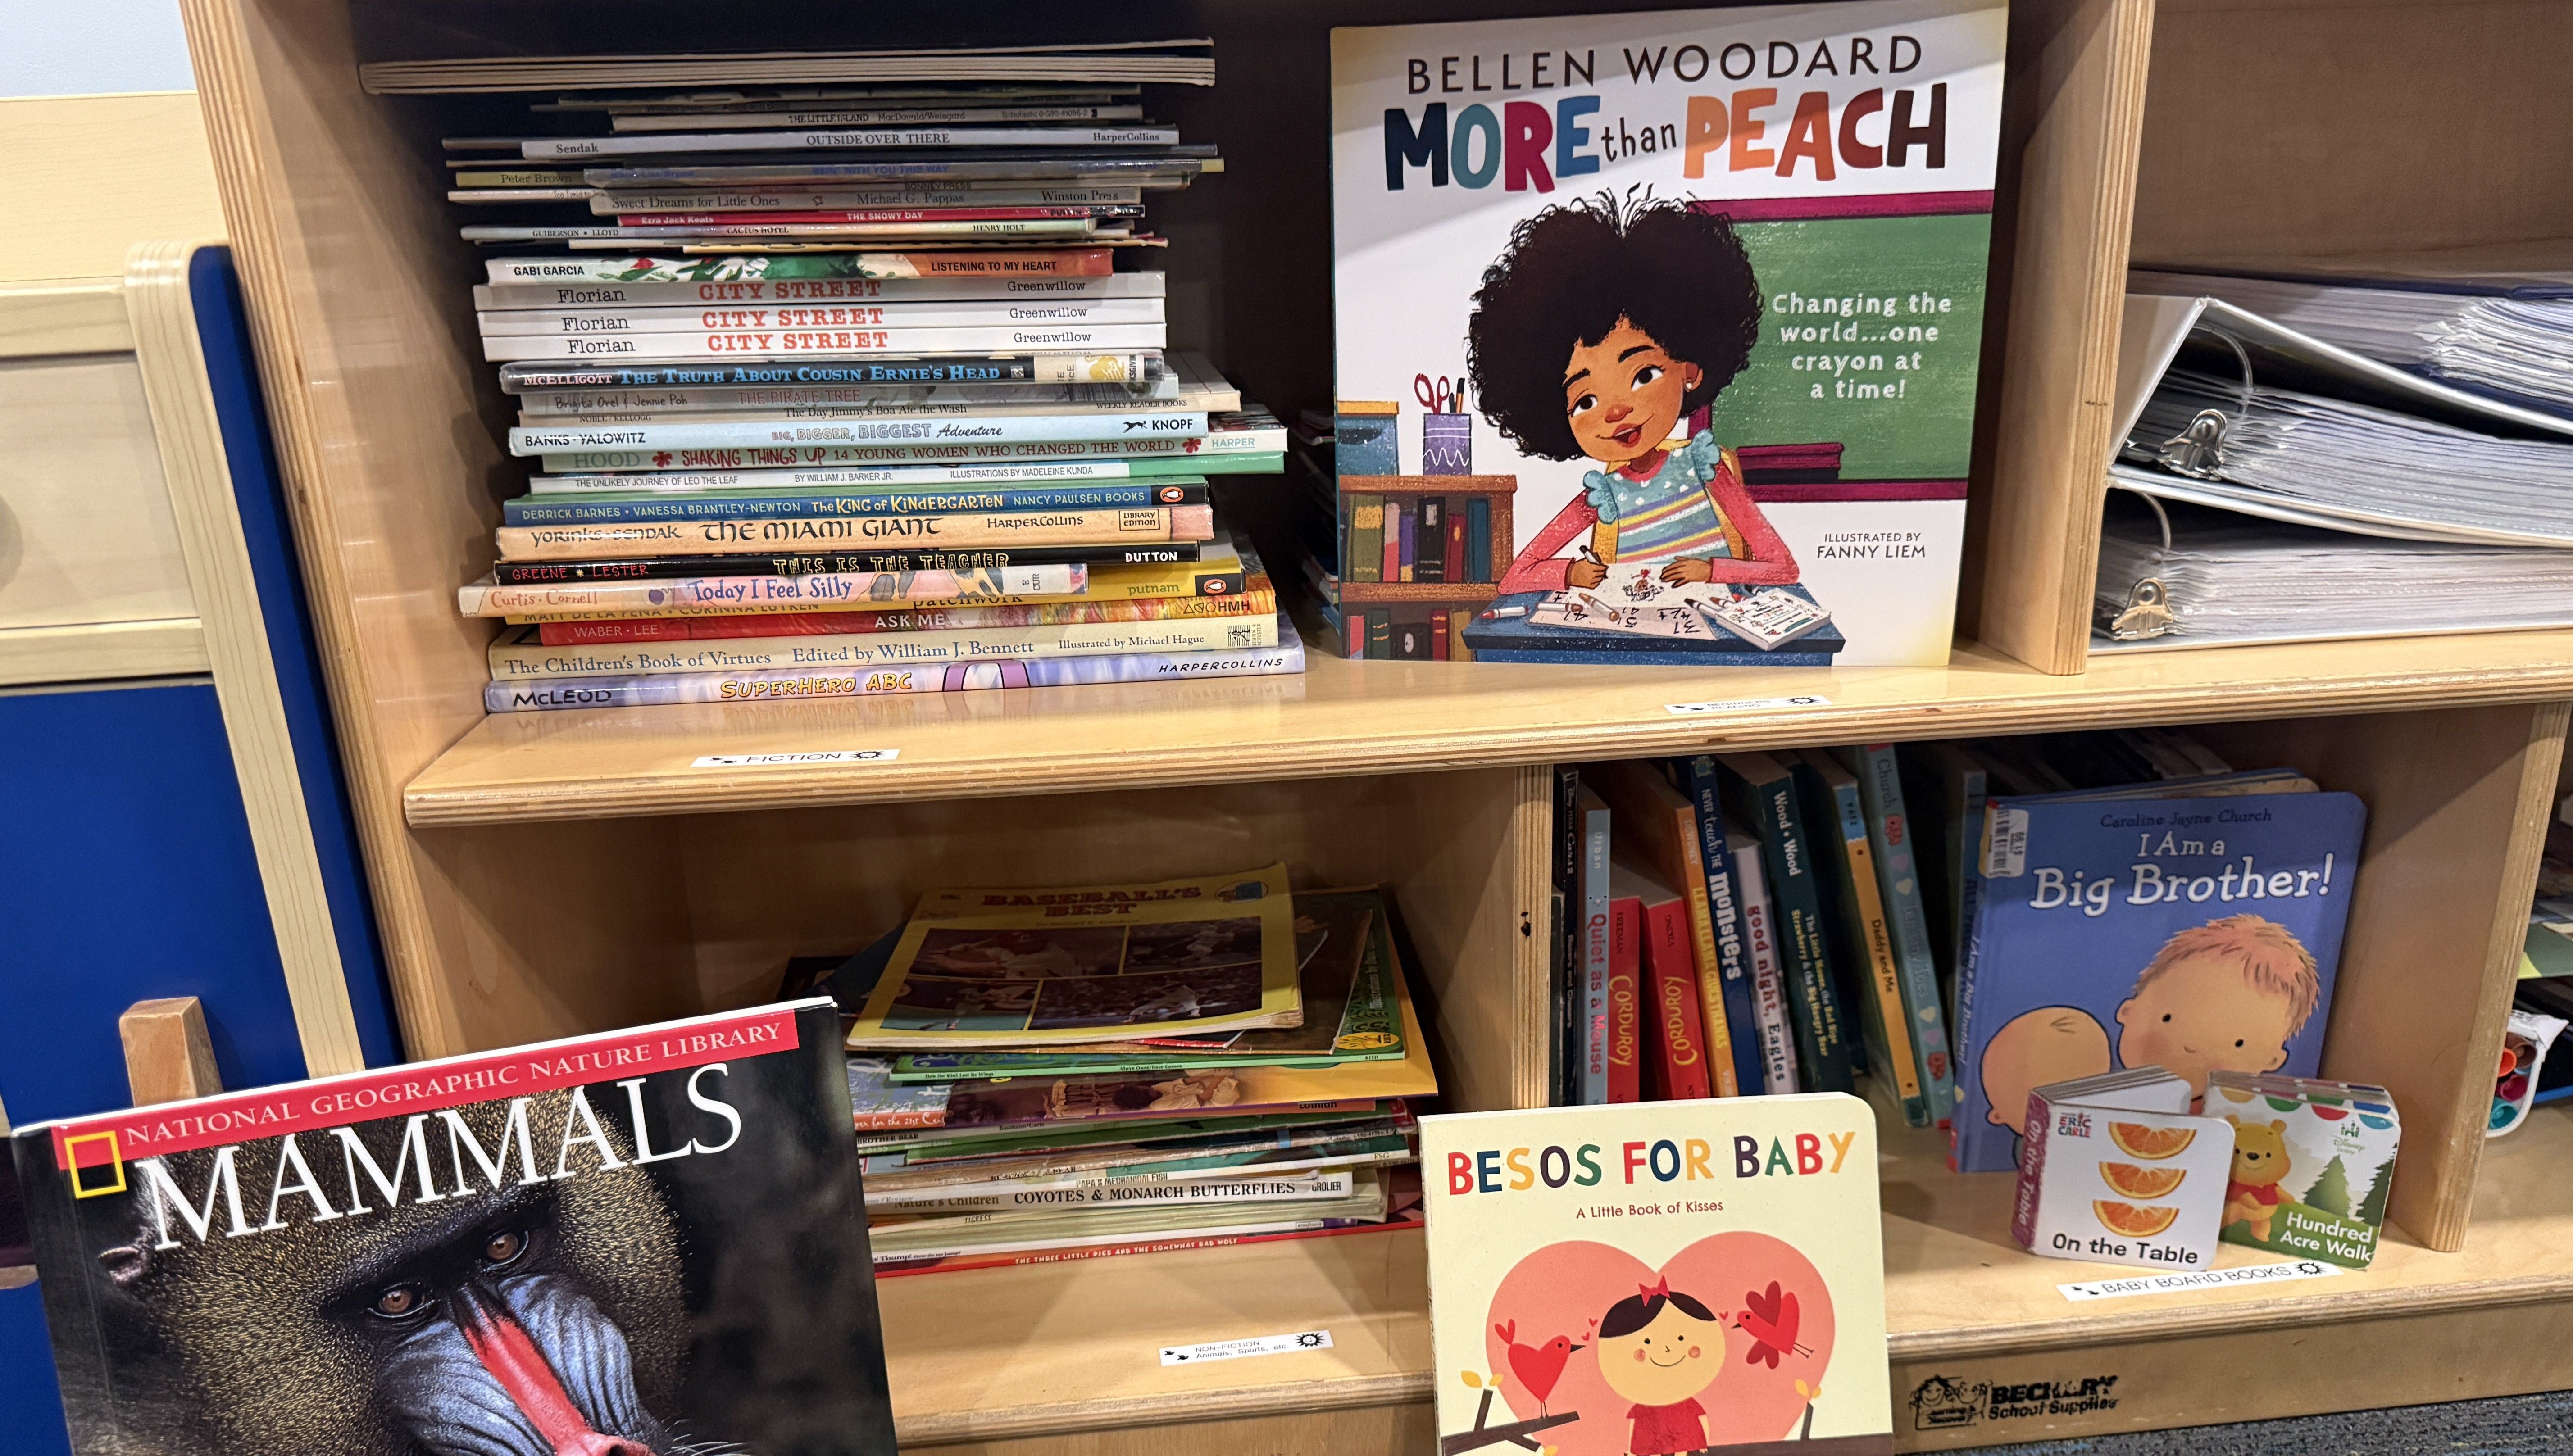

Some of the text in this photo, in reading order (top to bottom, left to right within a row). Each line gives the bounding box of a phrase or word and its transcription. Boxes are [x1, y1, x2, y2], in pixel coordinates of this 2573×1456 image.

[1408, 36, 1922, 94] BELLEN WOODARD
[807, 133, 950, 145] OUTSIDE OVER THERE
[1093, 132, 1160, 142] HarperCollins
[1384, 83, 1946, 193] MORE than PEACH
[556, 143, 599, 154] Sendak
[501, 174, 572, 183] Peter Brown
[612, 195, 780, 209] Sweet Dreams for Little Ones
[514, 265, 585, 276] GABI GARCIA
[932, 260, 1057, 272] LISTENING TO MY HEART
[699, 281, 881, 301] CITY STREET
[1008, 281, 1086, 292] Greenwillow
[557, 289, 626, 304] Florian
[1772, 292, 1952, 317] Changing the
[702, 308, 884, 328] CITY STREET
[1009, 307, 1088, 319] Greenwillow
[562, 317, 630, 331] Florian
[567, 339, 636, 354] Florian
[708, 331, 888, 351] CITY STREET
[1014, 331, 1092, 343] Greenwillow
[1791, 352, 1922, 377] crayon at
[1810, 379, 1906, 399] a time!
[1152, 419, 1193, 431] KNOPF
[834, 440, 1175, 461] 14 YOUNG WOMEN WHO CHANGED THE WORLD
[1212, 437, 1255, 448] HARPER
[1014, 492, 1145, 505] NANCY PAULSEN BOOKS
[1824, 532, 1921, 543] ILLUSTRATED BY
[1125, 552, 1178, 563] DUTTON
[1817, 545, 1926, 559] FANNY LIEM
[512, 564, 649, 581] GREENE LESTER
[687, 575, 853, 601] Today I Feel Silly
[1127, 584, 1180, 595] putnam
[1218, 601, 1250, 612] HMH
[875, 612, 946, 629] ASK ME
[574, 625, 659, 637] WABER LEE
[791, 640, 1034, 663] Edited by William J. Bennett
[505, 650, 772, 674] The Children's Book of Virtues
[1159, 658, 1283, 673] HARPERCOLLINS
[720, 672, 913, 699] SUPERHERO ABC
[746, 753, 841, 762] FICTION
[2101, 808, 2272, 828] Caroline Jayne Church
[1773, 791, 1802, 878] Wood Wood
[2137, 830, 2226, 857] I Am a
[2029, 852, 2334, 917] Big Brother!
[982, 886, 1202, 906] BASEBALL'S
[1044, 903, 1136, 916] BEST
[1587, 913, 1606, 1075] Quiet as a Mouse
[1746, 904, 1785, 1081] good night, Eagles
[1609, 975, 1633, 1066] CORDUROY
[1664, 976, 1698, 1066] CORDUROY
[127, 1021, 783, 1147] NATIONAL GEOGRAPHIC NATURE LIBRARY
[134, 1063, 744, 1251] MAMMALS
[1448, 1131, 1855, 1196] BESOS FOR BABY
[2018, 1119, 2042, 1226] On the Table
[1014, 1183, 1296, 1204] COYOTES & MONARCH BUTTERFLIES
[1312, 1181, 1341, 1192] GROLIER
[1576, 1200, 1724, 1219] A Little Book of Kisses
[964, 1215, 991, 1224] TIGRESS
[2287, 1212, 2372, 1244] Hundred
[1115, 1247, 1130, 1256] AND
[1152, 1242, 1195, 1251] SOMEWHAT
[2052, 1232, 2198, 1265] On the Table
[2280, 1230, 2373, 1261] Acre Walk
[2101, 1266, 2293, 1294] BABY BOARD BOOKS
[1196, 1341, 1259, 1352] NON-FICTION
[1989, 1401, 2046, 1420] School
[2049, 1395, 2119, 1415] Supplies
